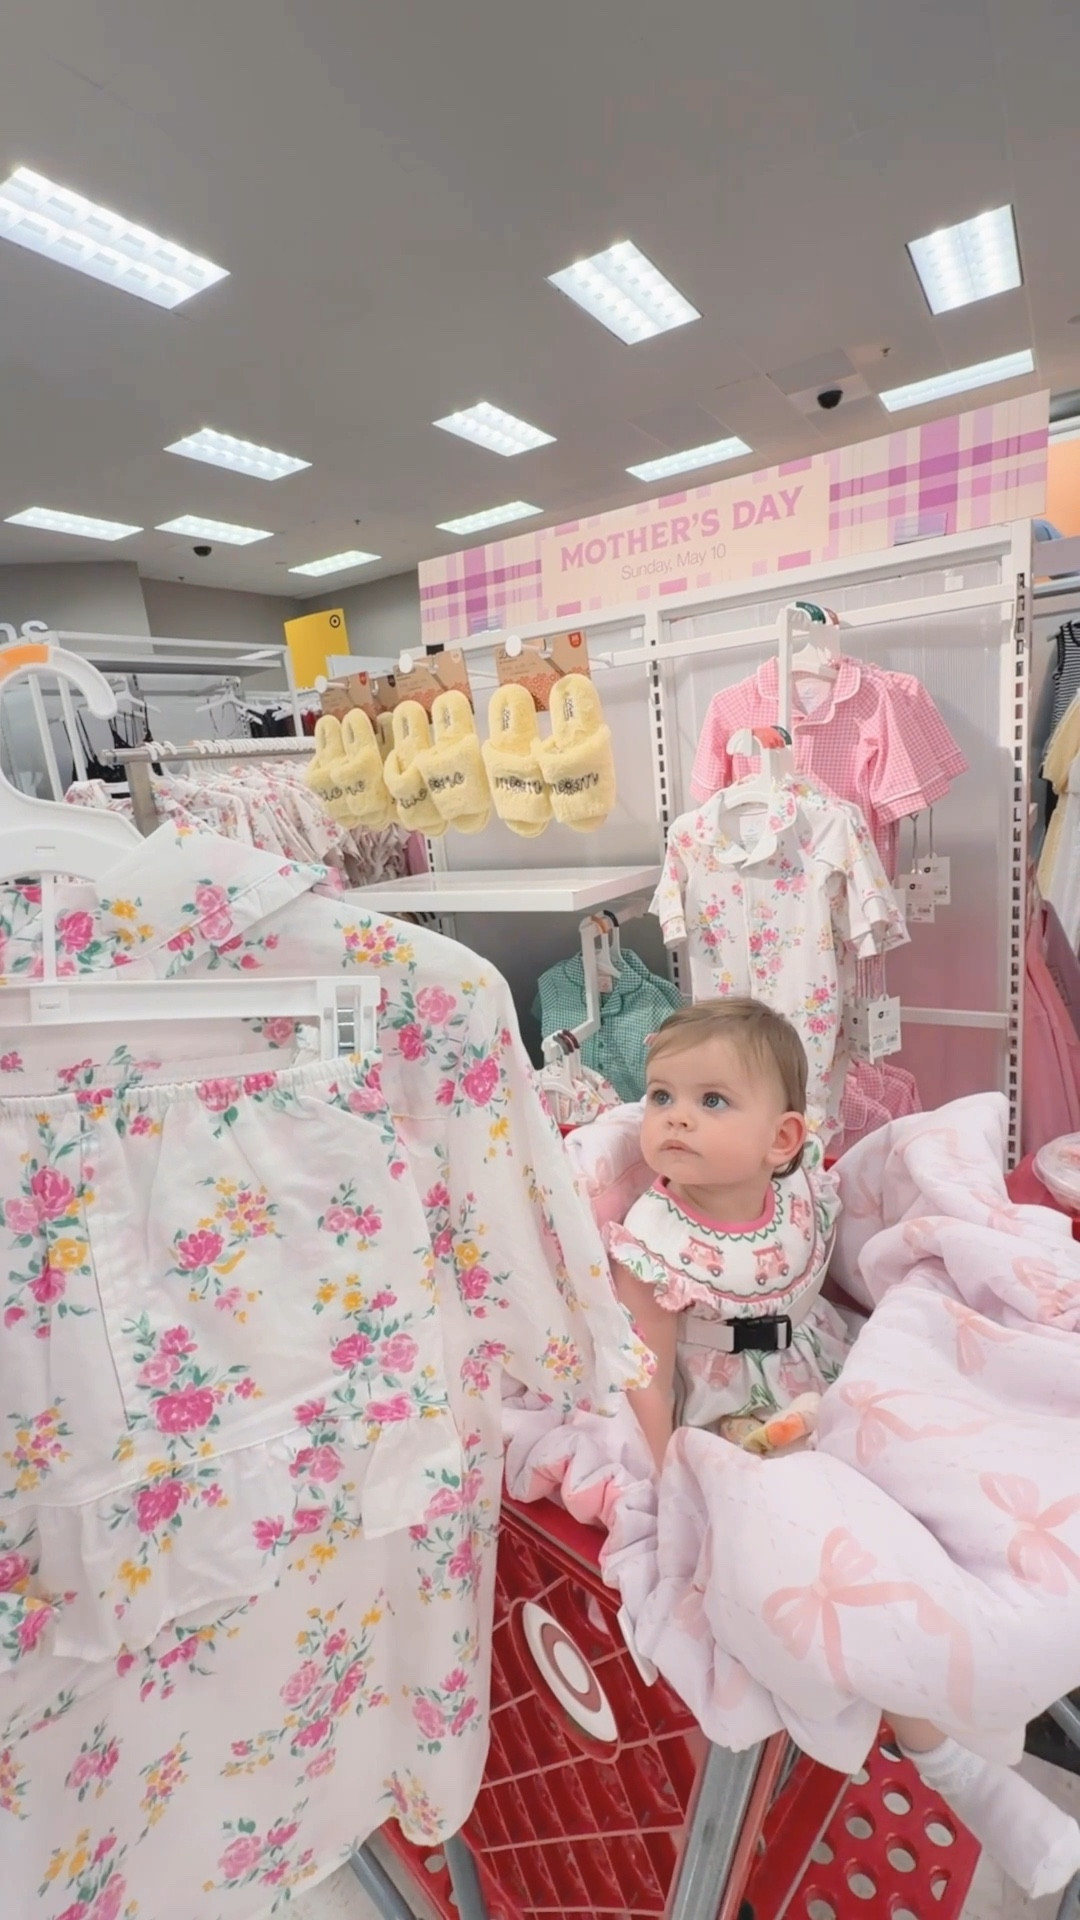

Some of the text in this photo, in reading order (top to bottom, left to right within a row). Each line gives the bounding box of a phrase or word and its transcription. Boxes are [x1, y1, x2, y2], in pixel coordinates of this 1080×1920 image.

[732, 485, 804, 531] DAY
[621, 543, 727, 581] Sunday, May 10
